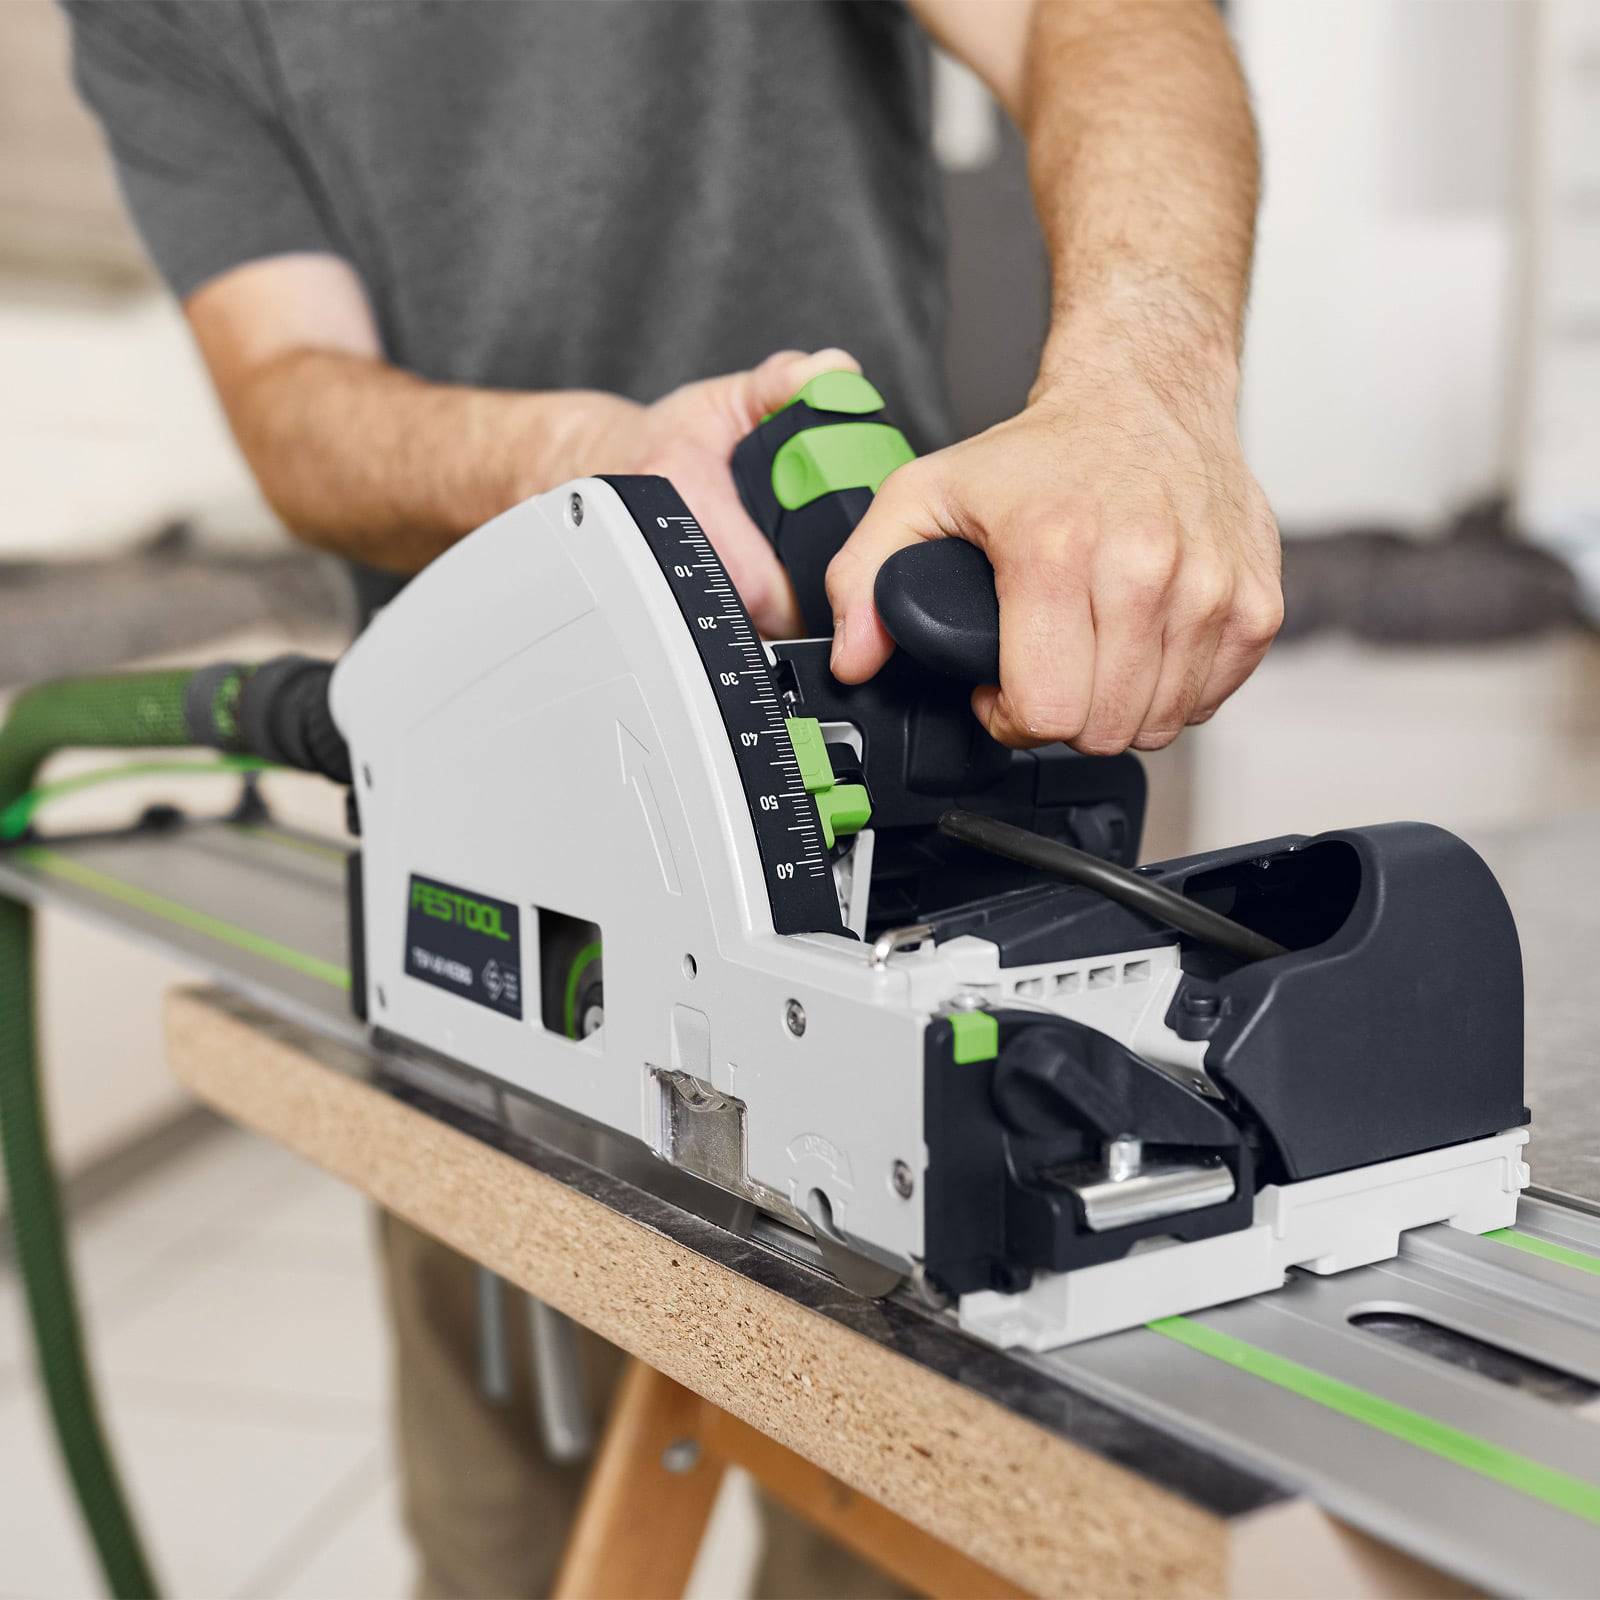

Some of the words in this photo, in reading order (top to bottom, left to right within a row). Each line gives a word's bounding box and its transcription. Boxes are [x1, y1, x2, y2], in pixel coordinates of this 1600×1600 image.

[656, 516, 669, 529] 0
[673, 565, 693, 578] 10
[697, 616, 718, 630] 20
[719, 672, 740, 686] 30
[740, 732, 759, 747] 40
[759, 795, 779, 811] 50
[776, 863, 794, 880] 60
[411, 881, 511, 942] FESTOOL
